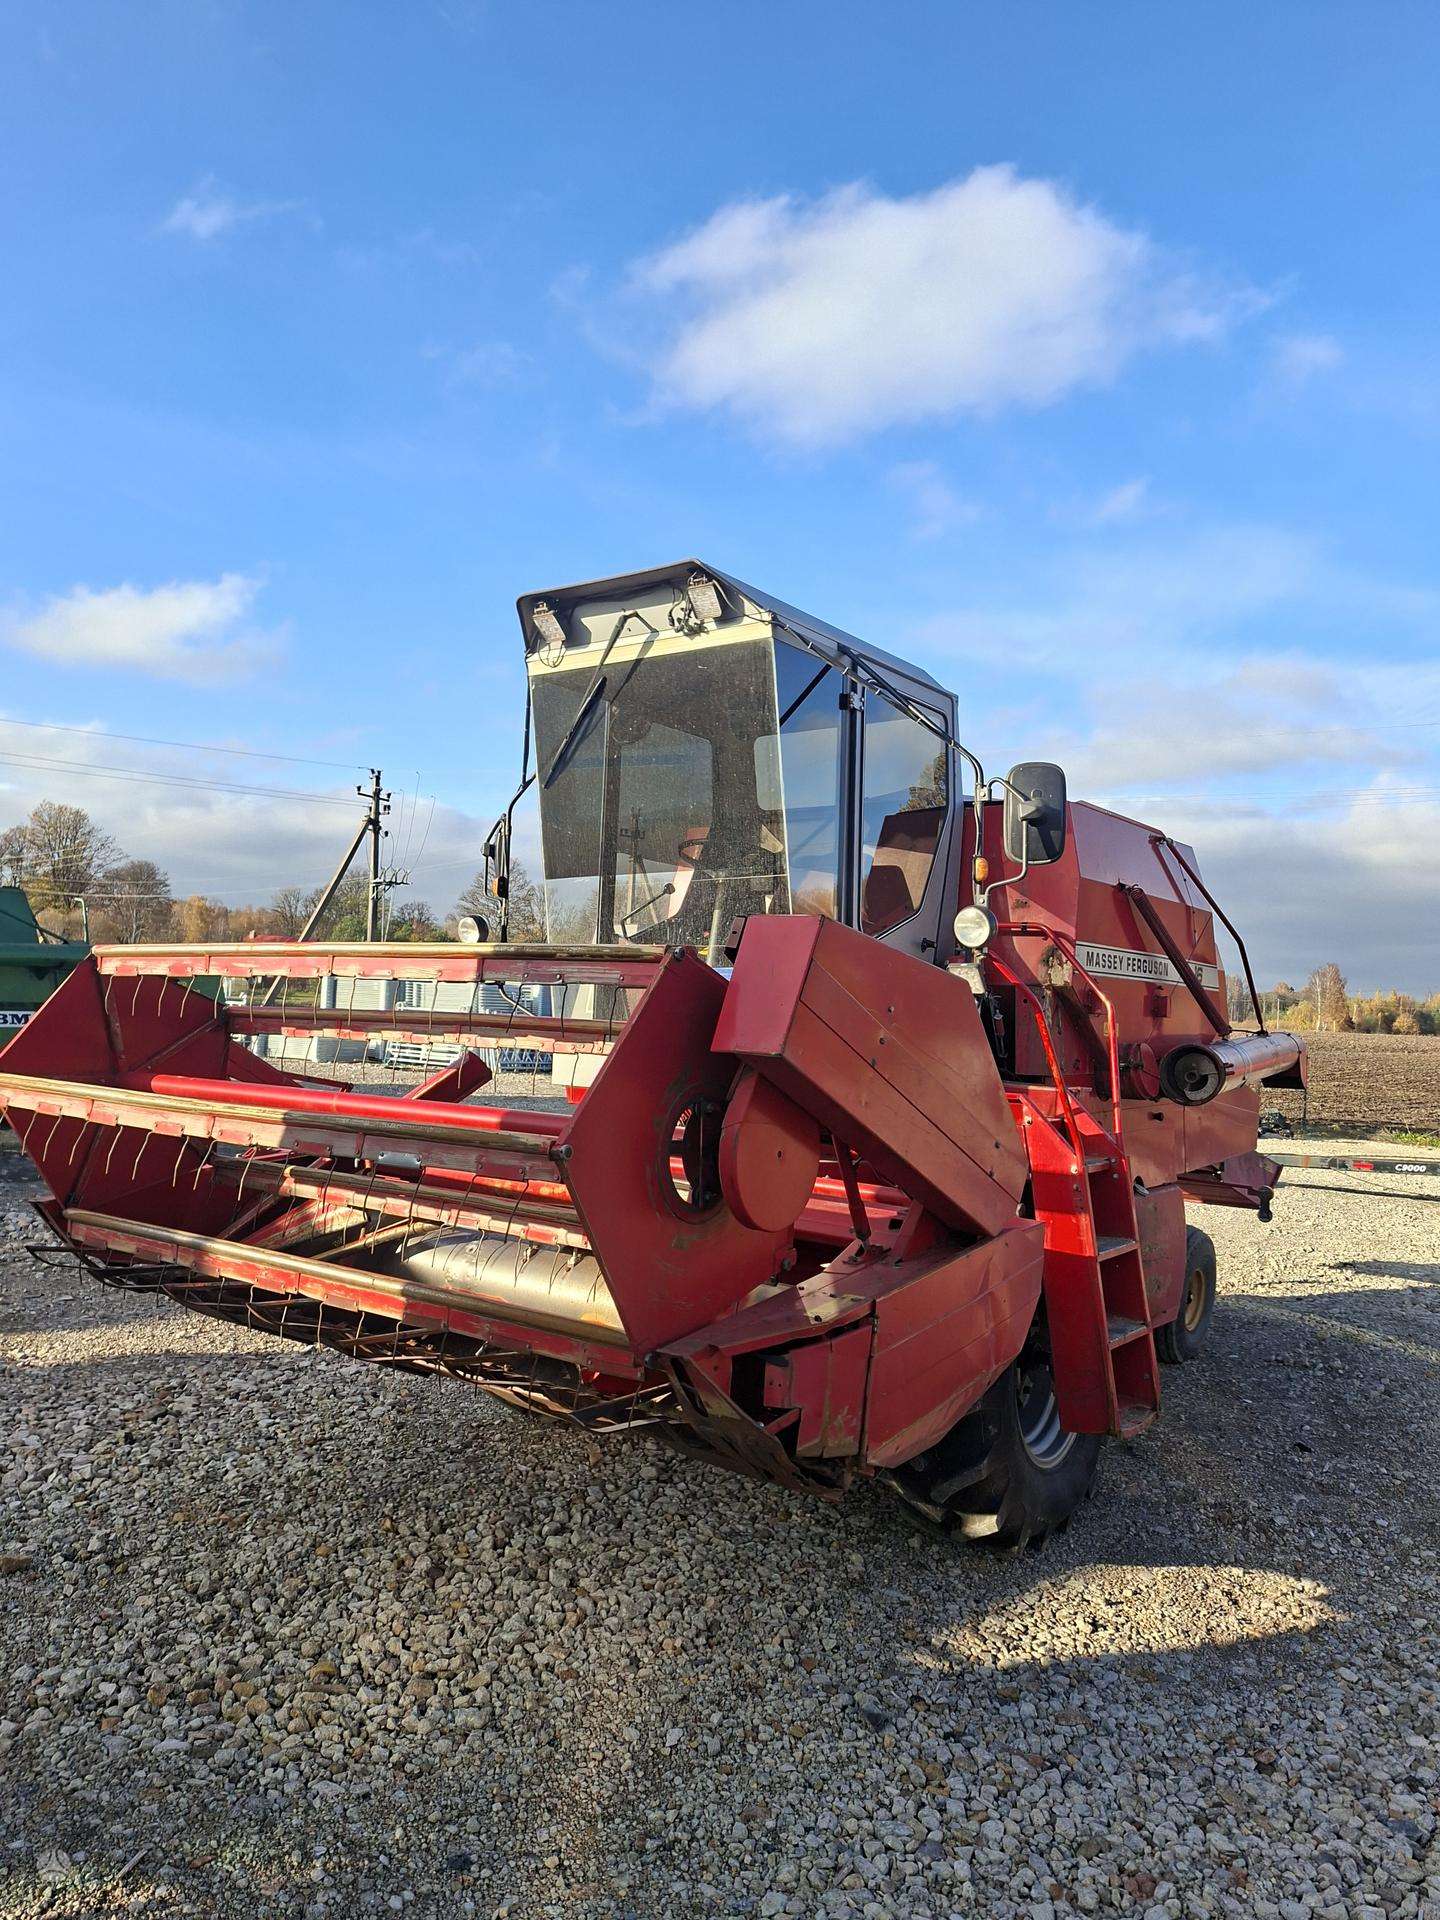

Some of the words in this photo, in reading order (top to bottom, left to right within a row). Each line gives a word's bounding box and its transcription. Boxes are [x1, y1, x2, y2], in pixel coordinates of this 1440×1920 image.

[1086, 950, 1123, 970] MASSEY
[1126, 956, 1169, 976] FERGUSON
[1395, 1163, 1427, 1172] C9000
